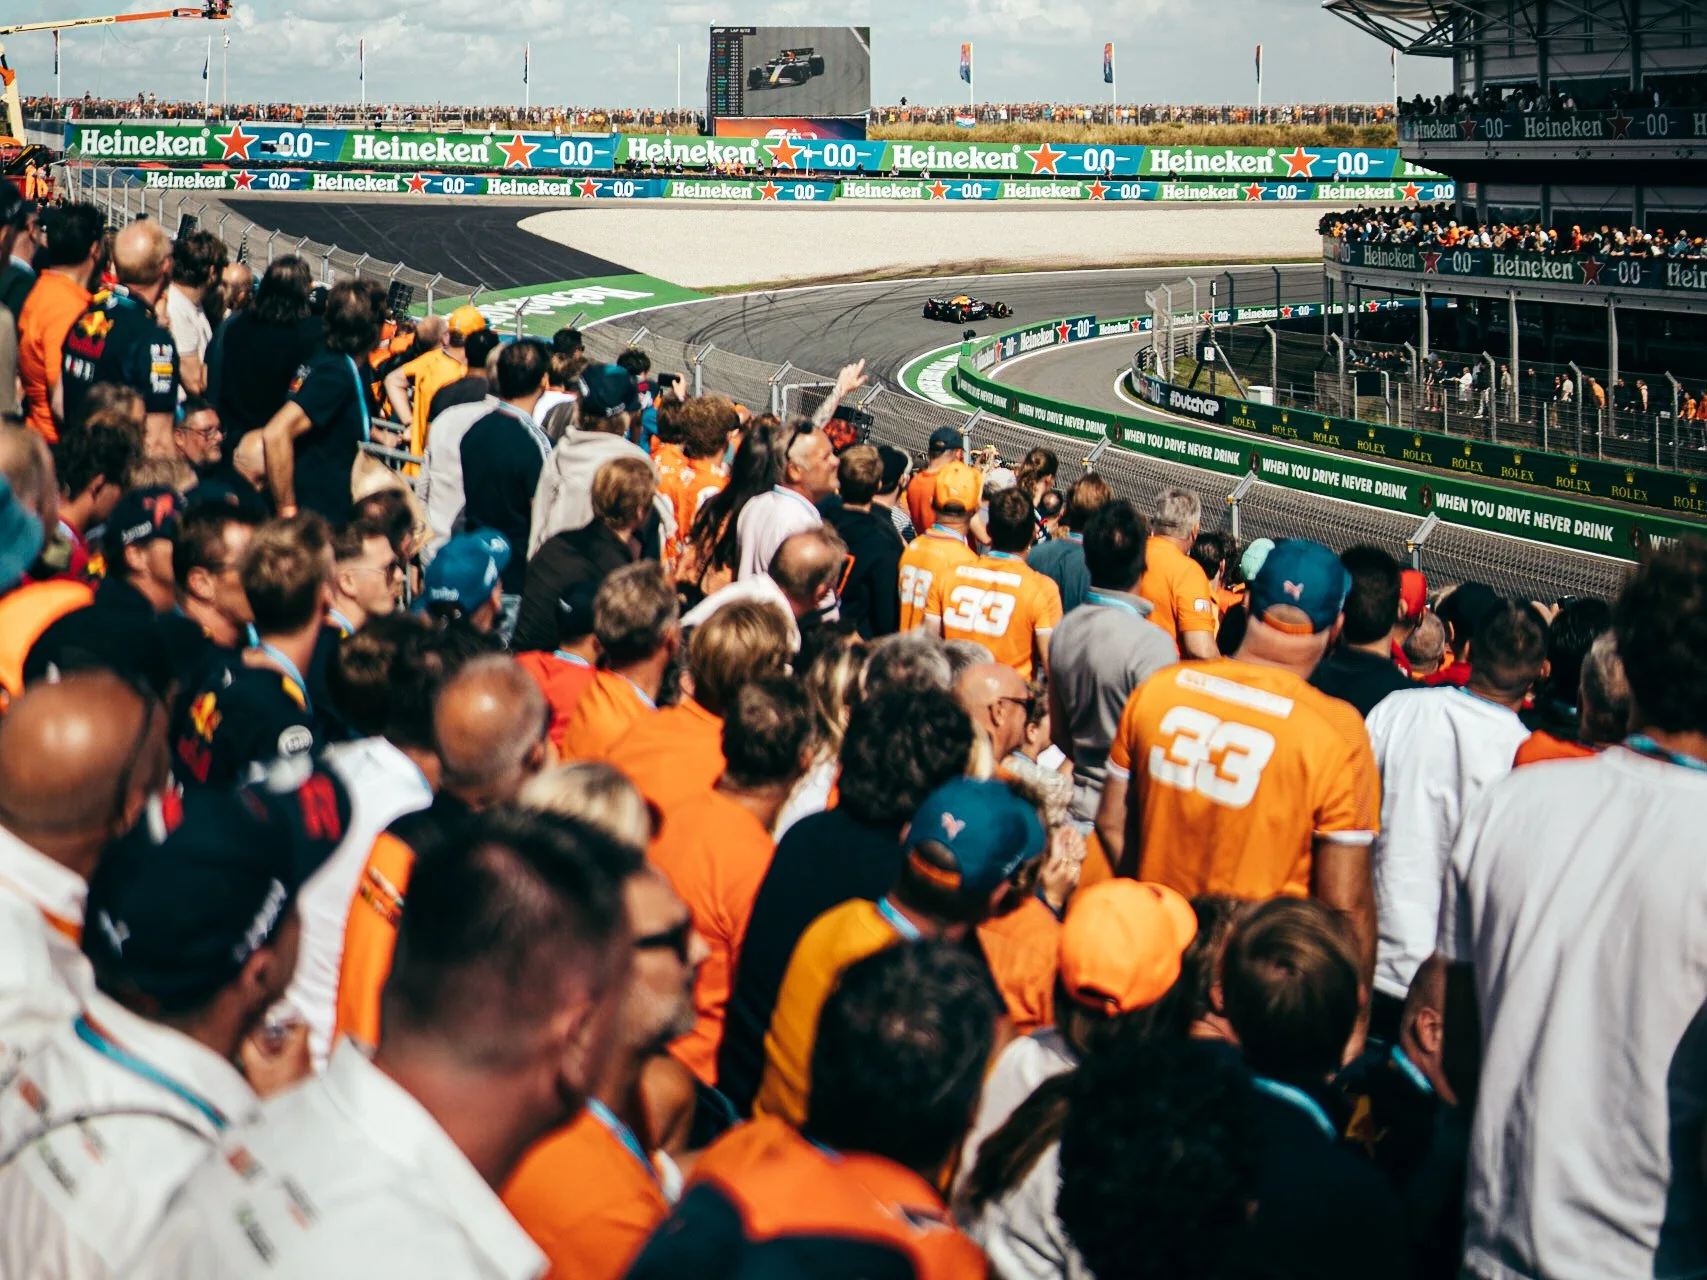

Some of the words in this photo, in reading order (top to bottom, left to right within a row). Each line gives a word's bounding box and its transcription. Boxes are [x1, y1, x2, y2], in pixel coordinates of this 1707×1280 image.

[1524, 115, 1602, 138] Heineken
[80, 129, 208, 157] Heineken
[353, 134, 489, 163] Heineken
[559, 141, 595, 166] 0.0
[627, 137, 757, 165] Heineken
[823, 141, 855, 168] 0.0
[893, 144, 1019, 170] Heineken
[1083, 148, 1115, 174] 0.0
[1149, 149, 1274, 175] Heineken
[1337, 152, 1369, 176] 0.0
[145, 171, 228, 190] Heineken
[269, 173, 290, 190] 0.0
[313, 173, 399, 192] Heineken
[443, 176, 465, 194] 0.0
[486, 177, 571, 196] Heineken
[613, 180, 634, 198] 0.0
[671, 180, 753, 199] Heineken
[794, 183, 815, 200] 0.0
[843, 181, 922, 199] Heineken
[961, 182, 982, 199] 0.0
[1003, 182, 1081, 199] Heineken
[1121, 183, 1141, 200] 0.0
[1162, 183, 1239, 200] Heineken
[1277, 184, 1297, 200] 0.0
[1318, 184, 1396, 200] Heineken
[1434, 184, 1455, 199] 0.0
[1364, 245, 1416, 269] Heineken
[1453, 251, 1472, 273] 0.0
[1493, 253, 1574, 280] Heineken
[1618, 261, 1640, 284] 0.0
[1238, 308, 1277, 320] Heineken
[1099, 321, 1130, 336] Heineken
[1019, 328, 1054, 352] Heineken
[1169, 390, 1219, 416] #DutchGP
[1018, 402, 1034, 416] WHEN
[1034, 407, 1047, 421] YOU
[1047, 410, 1063, 425] DRIVE
[1063, 415, 1085, 431] NEVER
[1085, 420, 1108, 435] DRINK
[1232, 416, 1257, 429] ROLEX
[1272, 425, 1298, 439] ROLEX
[1313, 431, 1340, 446] ROLEX
[1124, 428, 1146, 445] WHEN
[1147, 433, 1163, 448] YOU
[1164, 437, 1186, 454] DRIVE
[1187, 443, 1212, 460] NEVER
[1213, 449, 1240, 465] DRINK
[1357, 440, 1386, 455] ROLEX
[1403, 449, 1433, 464] ROLEX
[1452, 457, 1483, 473] ROLEX
[1501, 466, 1535, 482] ROLEX
[1262, 458, 1288, 476] WHEN
[1290, 464, 1310, 481] YOU
[1312, 468, 1339, 487] DRIVE
[1342, 474, 1372, 493] NEVER
[1374, 483, 1407, 501] DRINK
[1556, 476, 1592, 492] ROLEX
[1611, 485, 1648, 501] ROLEX
[1436, 492, 1468, 513] WHEN
[1470, 499, 1494, 518] YOU
[1497, 504, 1531, 525] DRIVE
[1533, 512, 1571, 535] NEVER
[1574, 520, 1614, 543] DRINK
[899, 565, 933, 608] 33
[943, 585, 1016, 638] 33
[1149, 705, 1276, 809] 33
